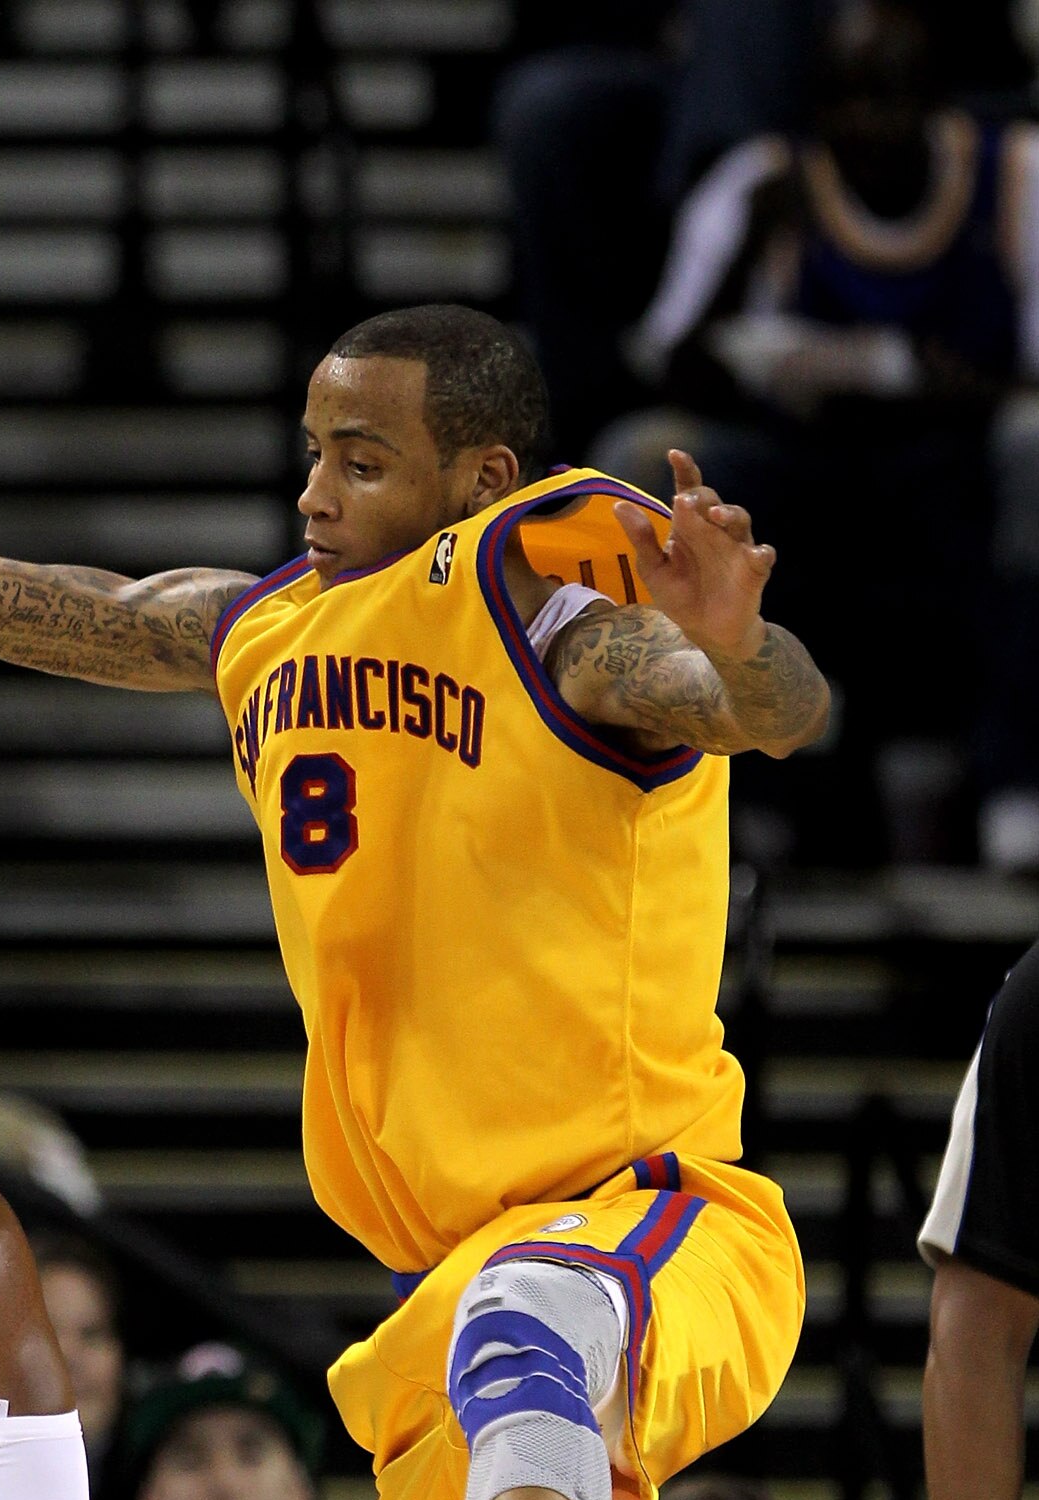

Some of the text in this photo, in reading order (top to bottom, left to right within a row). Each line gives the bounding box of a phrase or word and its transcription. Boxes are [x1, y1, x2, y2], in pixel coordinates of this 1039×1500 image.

[47, 612, 84, 632] 3:16
[261, 654, 486, 770] FRANCISCO
[280, 752, 359, 876] 8
